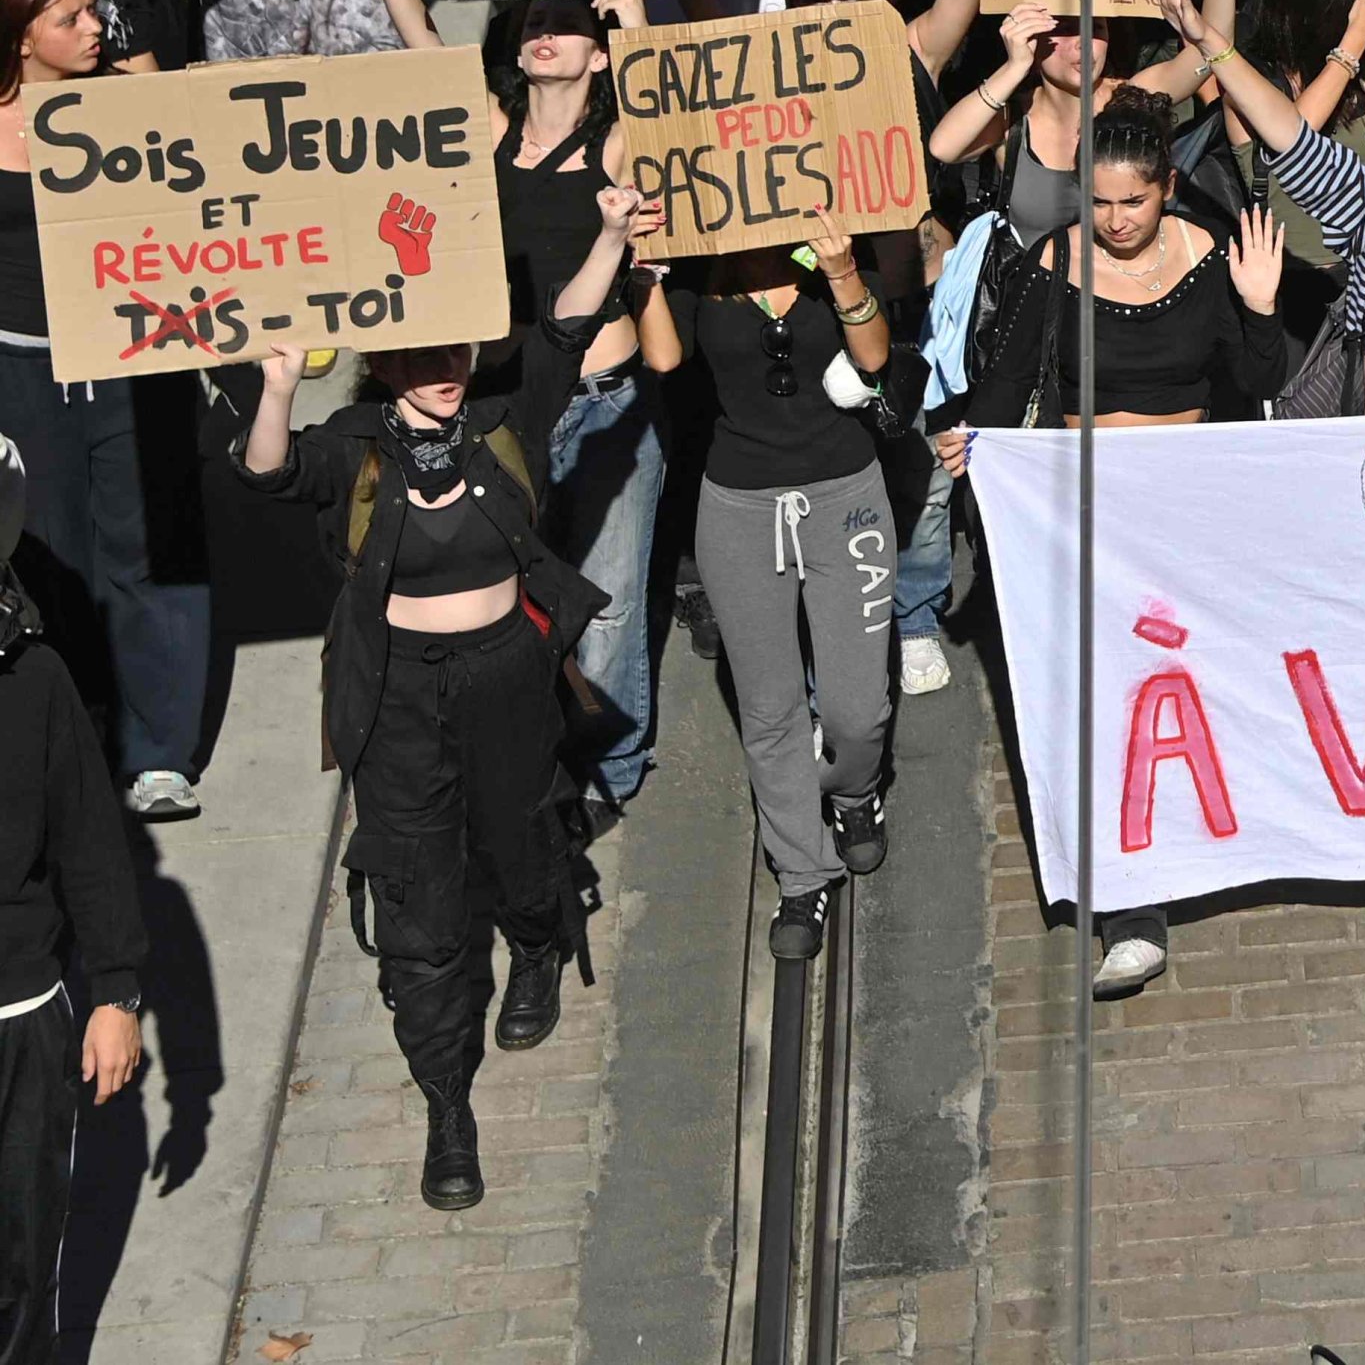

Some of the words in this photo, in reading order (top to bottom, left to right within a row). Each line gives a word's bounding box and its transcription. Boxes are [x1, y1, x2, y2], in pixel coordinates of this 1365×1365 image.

[616, 34, 756, 119] GAZEZ
[771, 18, 867, 99] LES
[229, 81, 472, 175] JEUNE
[715, 97, 817, 151] PEDO
[201, 193, 262, 230] ET
[632, 144, 734, 237] PAS
[736, 141, 834, 226] LES
[837, 125, 917, 214] ADO
[93, 225, 330, 290] RÉVOLTE
[847, 529, 892, 634] CALI
[1119, 615, 1239, 853] À
